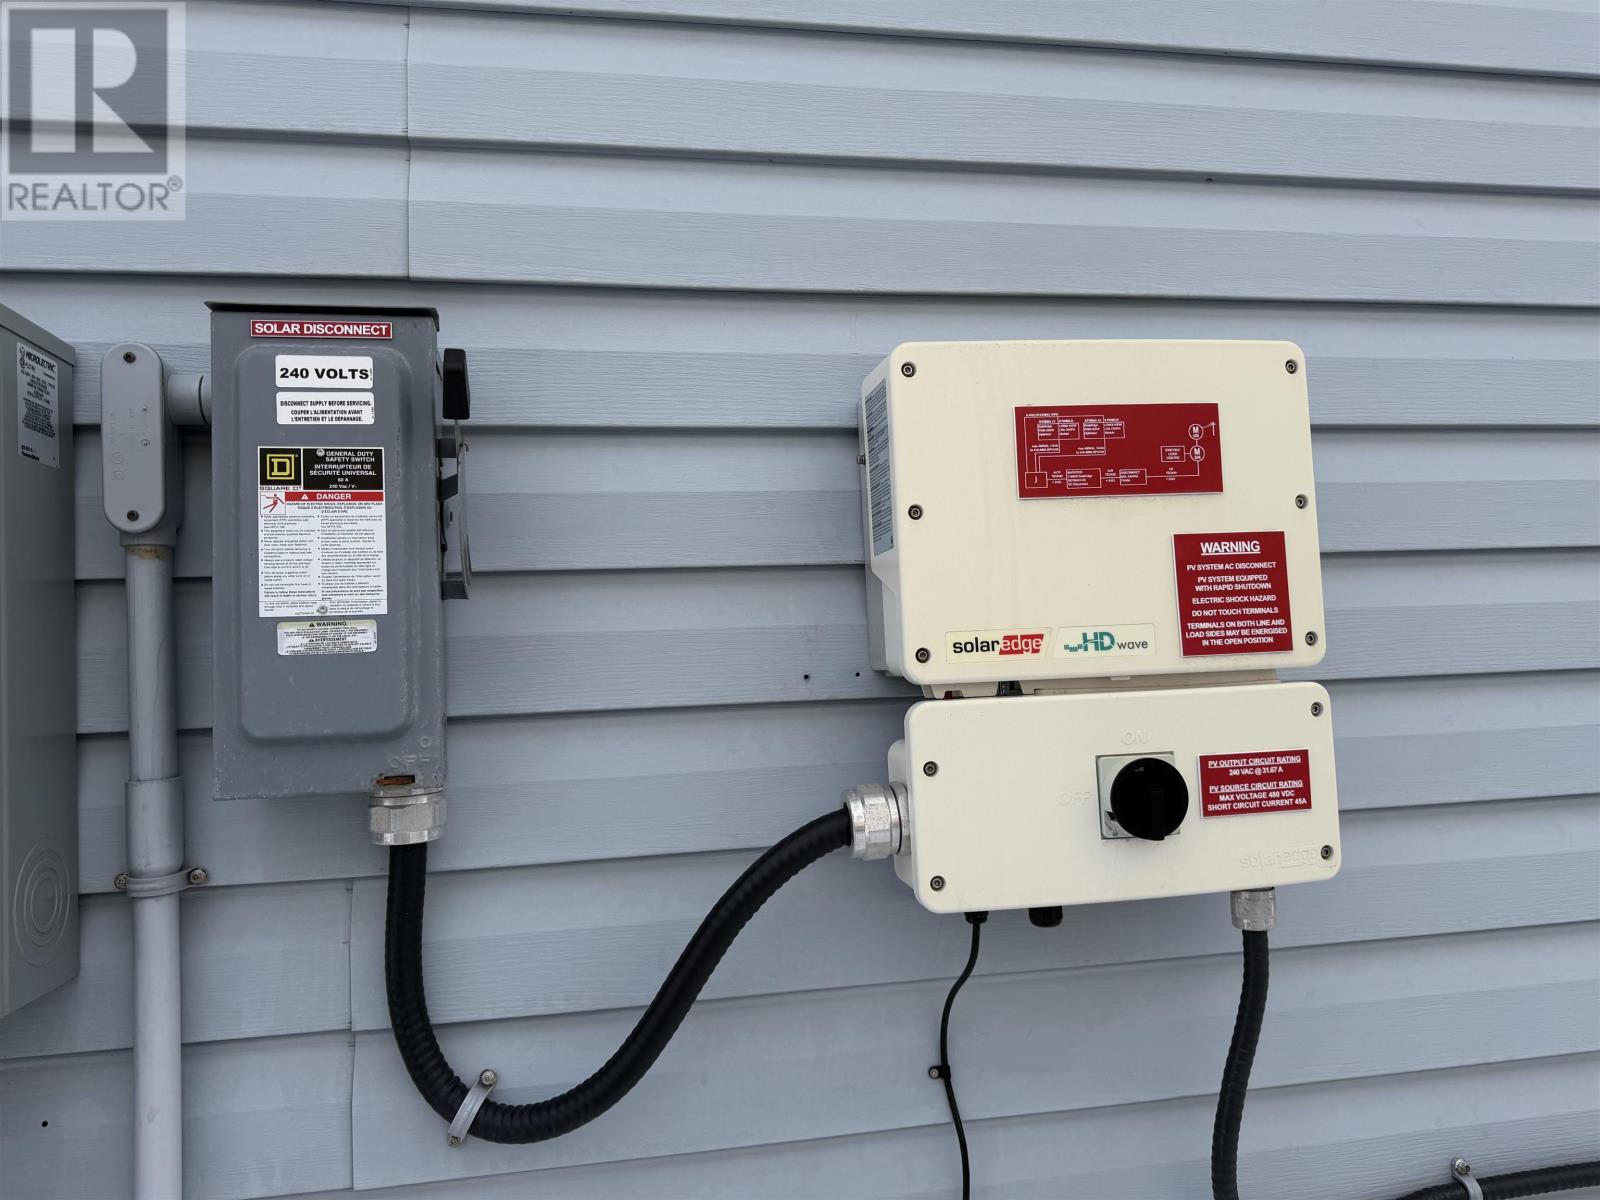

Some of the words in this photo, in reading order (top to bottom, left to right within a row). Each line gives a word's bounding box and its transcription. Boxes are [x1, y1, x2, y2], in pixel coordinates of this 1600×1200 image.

[255, 323, 300, 334] SOLAR
[303, 324, 388, 336] DISCONNECT
[280, 368, 309, 379] 240
[314, 368, 369, 380] VOLTS
[1200, 541, 1260, 553] WARNING
[952, 634, 1042, 654] solaredge
[1082, 631, 1116, 651] HD
[1117, 641, 1148, 650] wave
[1122, 729, 1147, 745] ON
[1057, 792, 1091, 806] OFF
